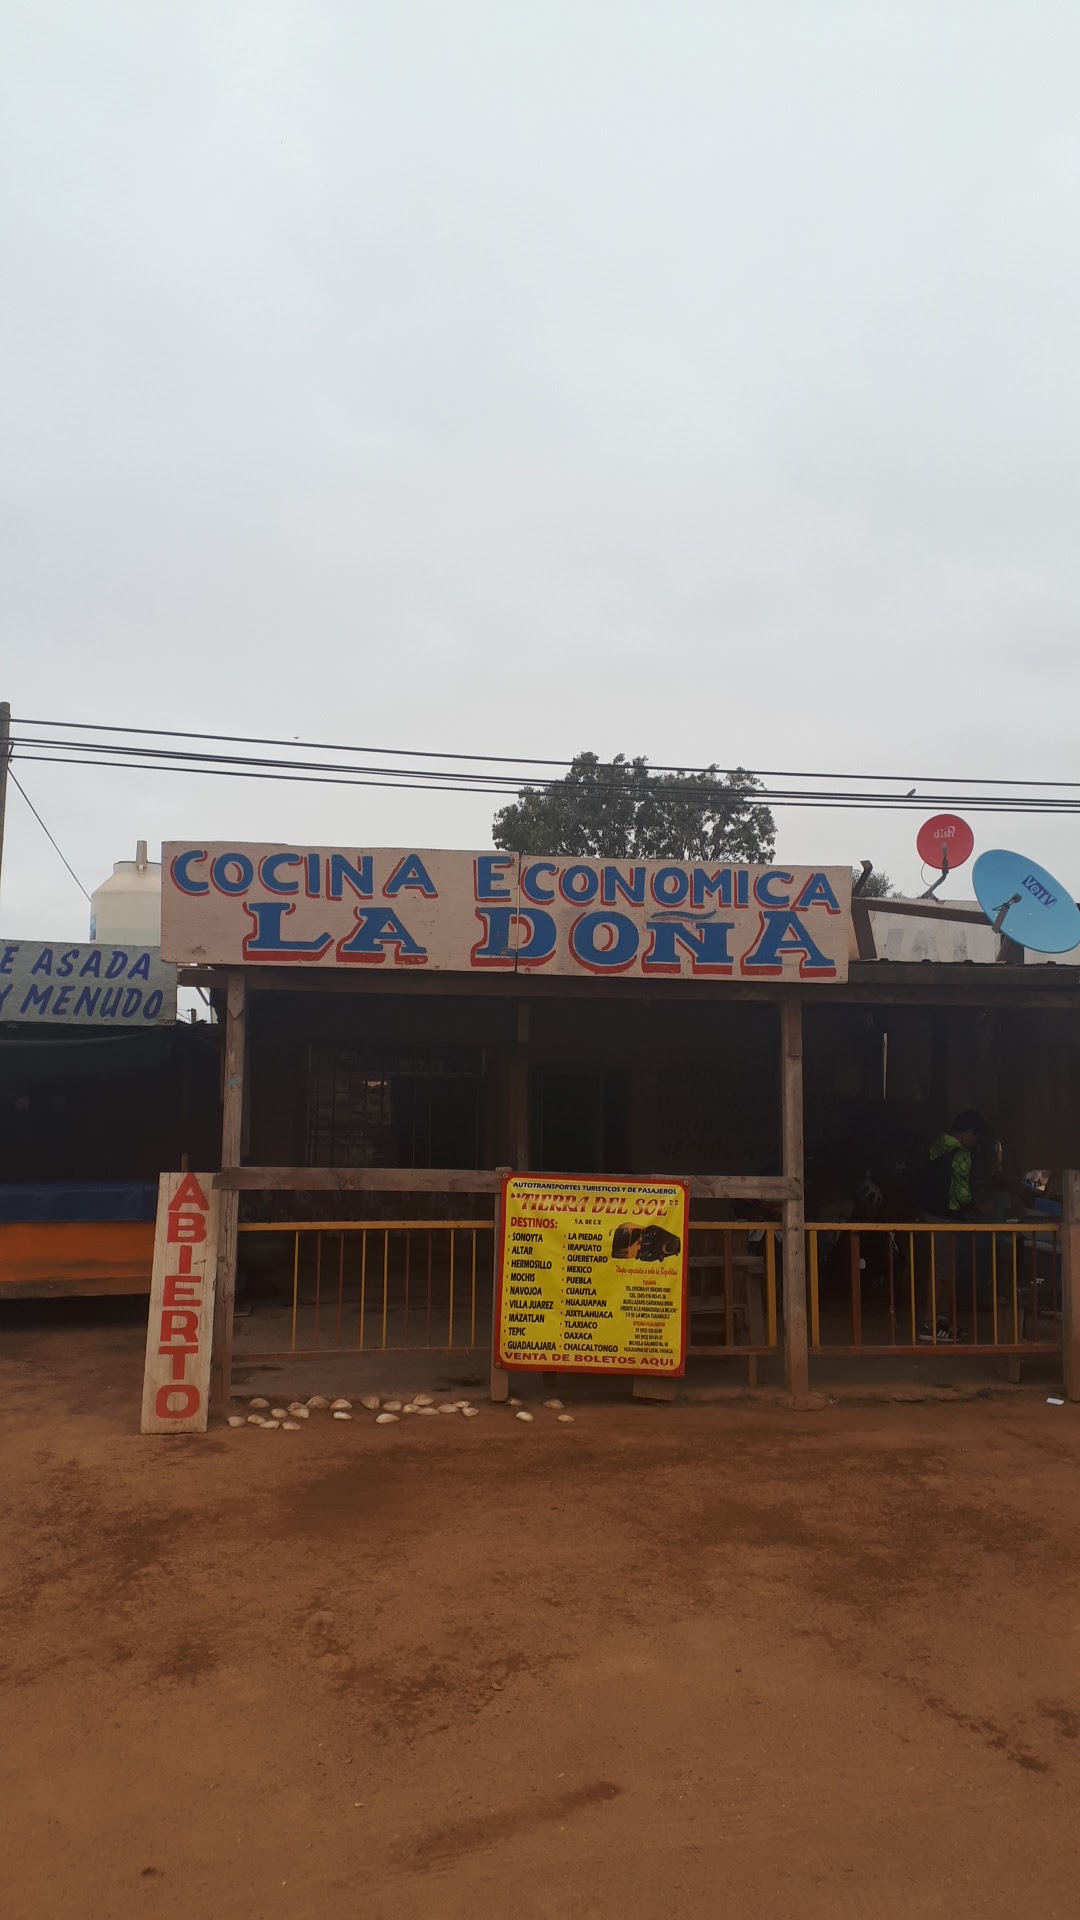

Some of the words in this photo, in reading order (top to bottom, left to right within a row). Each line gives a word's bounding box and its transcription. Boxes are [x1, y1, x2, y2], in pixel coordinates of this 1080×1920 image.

[934, 826, 956, 838] dish
[170, 848, 439, 903] COCINA
[472, 854, 842, 914] ECONOMICA
[241, 901, 428, 965] LA
[470, 906, 838, 978] DOÑA
[31, 947, 152, 981] ASADA
[20, 983, 164, 1020] MENUDO
[512, 1182, 580, 1190] AUTOTRANSPORTES
[592, 1196, 628, 1216] DEL
[510, 1216, 558, 1230] DESTINOS:
[512, 1232, 543, 1242] SONOYTA
[578, 1233, 602, 1241] PIEDAD
[512, 1246, 533, 1255] ALTAR
[567, 1244, 602, 1252] IRAPUATO
[567, 1254, 608, 1263] QUERETARO
[511, 1259, 552, 1270] HERMOSILLO
[566, 1266, 592, 1274] MEXICO
[510, 1272, 536, 1282] MOCHIS
[566, 1276, 592, 1285] PUEBLA
[510, 1286, 542, 1296] NAVOJOA
[565, 1288, 597, 1296] CUAUTLA
[155, 1172, 210, 1420] ABIERTO
[509, 1300, 528, 1309] VILLA
[529, 1301, 554, 1310] JUAREZ
[565, 1299, 607, 1307] HUAJUAPAN
[508, 1314, 545, 1323] MAZATLAN
[565, 1310, 613, 1319] JUXTLAHUACA
[564, 1321, 598, 1329] TLAXIACO
[508, 1327, 526, 1336] TEPIC
[564, 1332, 592, 1340] OAXACA
[507, 1341, 556, 1351] GUADALAJARA
[563, 1344, 619, 1353] CHALCALTONGO
[504, 1352, 548, 1362] VENTA
[551, 1354, 571, 1362] DE
[574, 1354, 636, 1365] BOLETOS
[640, 1357, 674, 1367] AQUI
